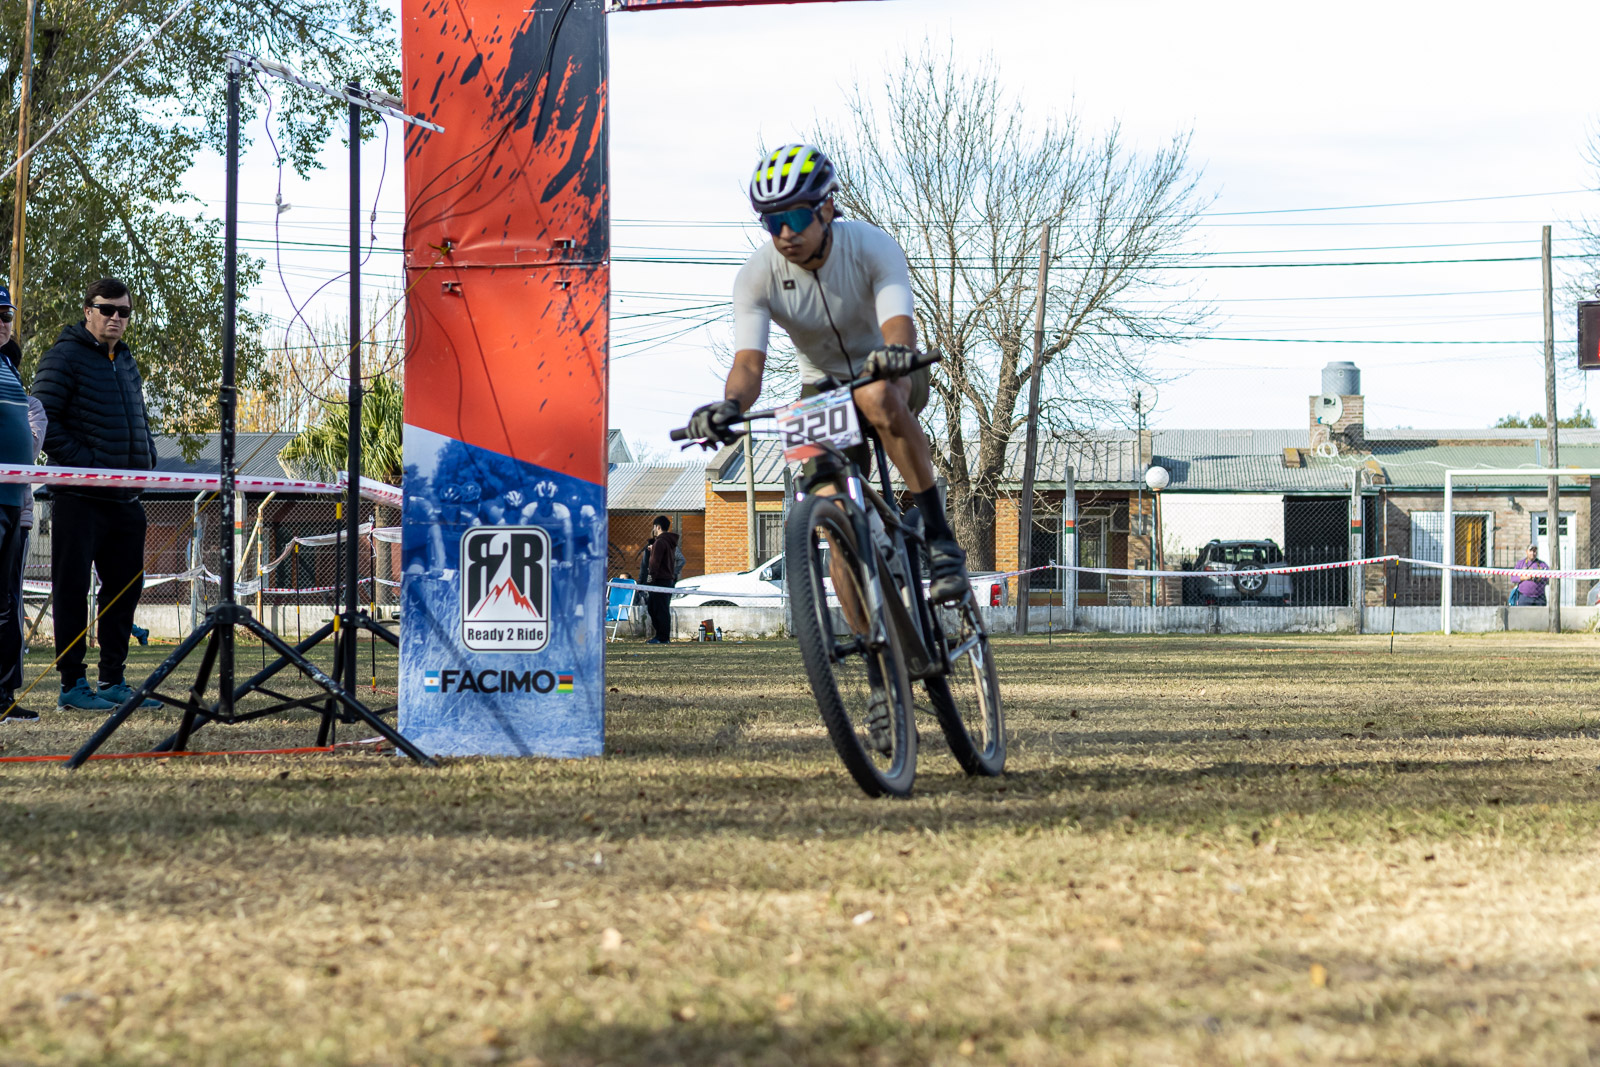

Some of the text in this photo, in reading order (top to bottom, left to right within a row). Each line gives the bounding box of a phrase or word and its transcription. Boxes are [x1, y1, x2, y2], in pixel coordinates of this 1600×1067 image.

[785, 404, 848, 448] 220
[467, 627, 544, 642] Ready 2 Ride
[441, 669, 556, 694] FACIMO
